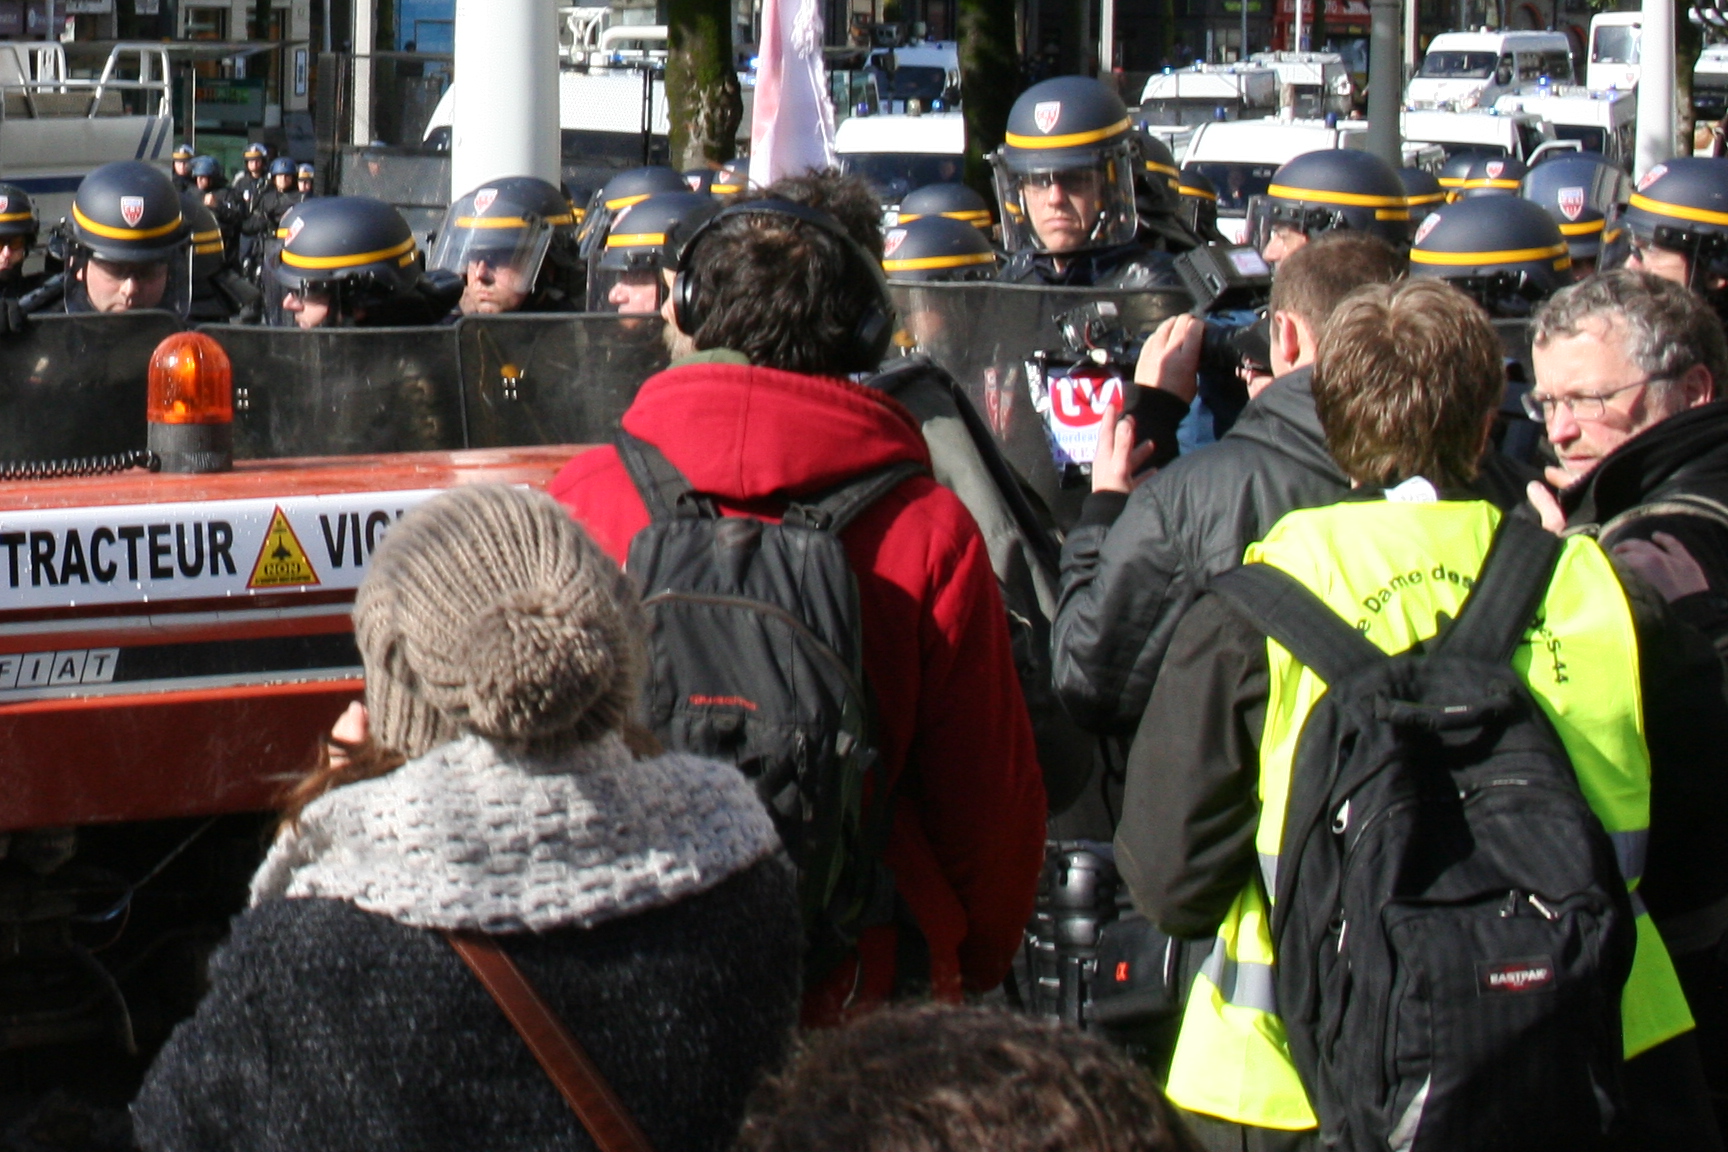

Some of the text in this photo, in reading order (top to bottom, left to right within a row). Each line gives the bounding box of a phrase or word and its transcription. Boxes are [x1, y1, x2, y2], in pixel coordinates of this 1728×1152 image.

[0, 509, 404, 588] TRACTEUR VIG
[265, 561, 300, 577] NON
[1363, 562, 1476, 614] Dame des
